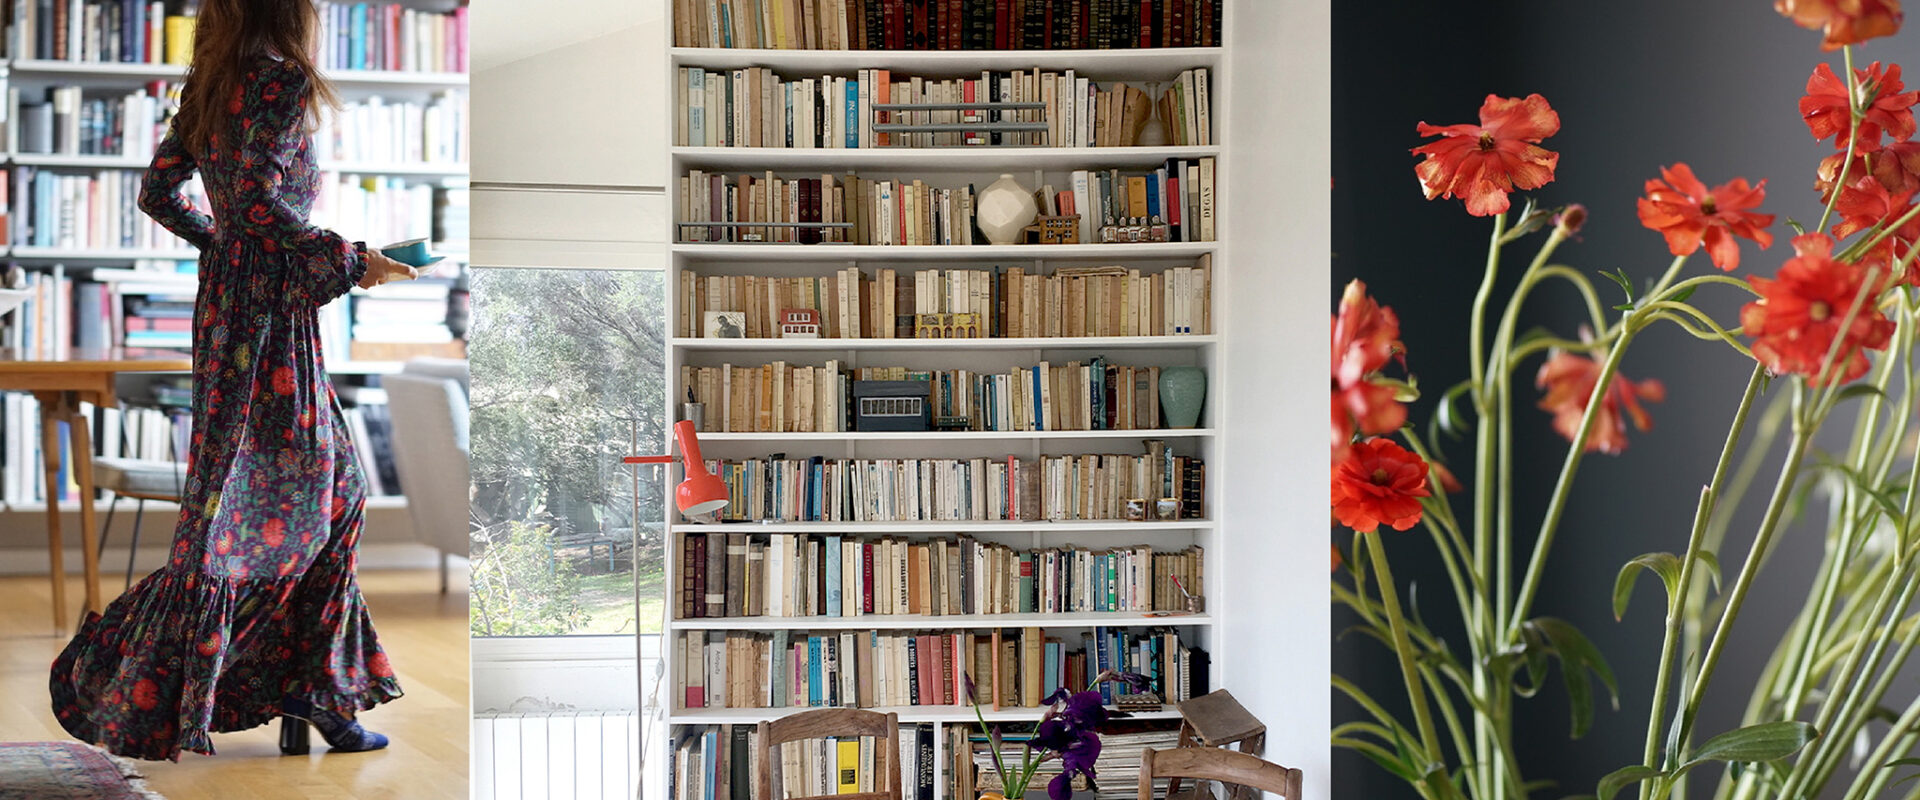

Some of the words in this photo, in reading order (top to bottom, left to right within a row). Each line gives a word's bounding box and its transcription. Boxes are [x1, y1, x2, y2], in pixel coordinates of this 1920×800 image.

[1203, 186, 1211, 218] DEGAS
[920, 743, 928, 788] MONUMENTS
[927, 775, 933, 785] DE
